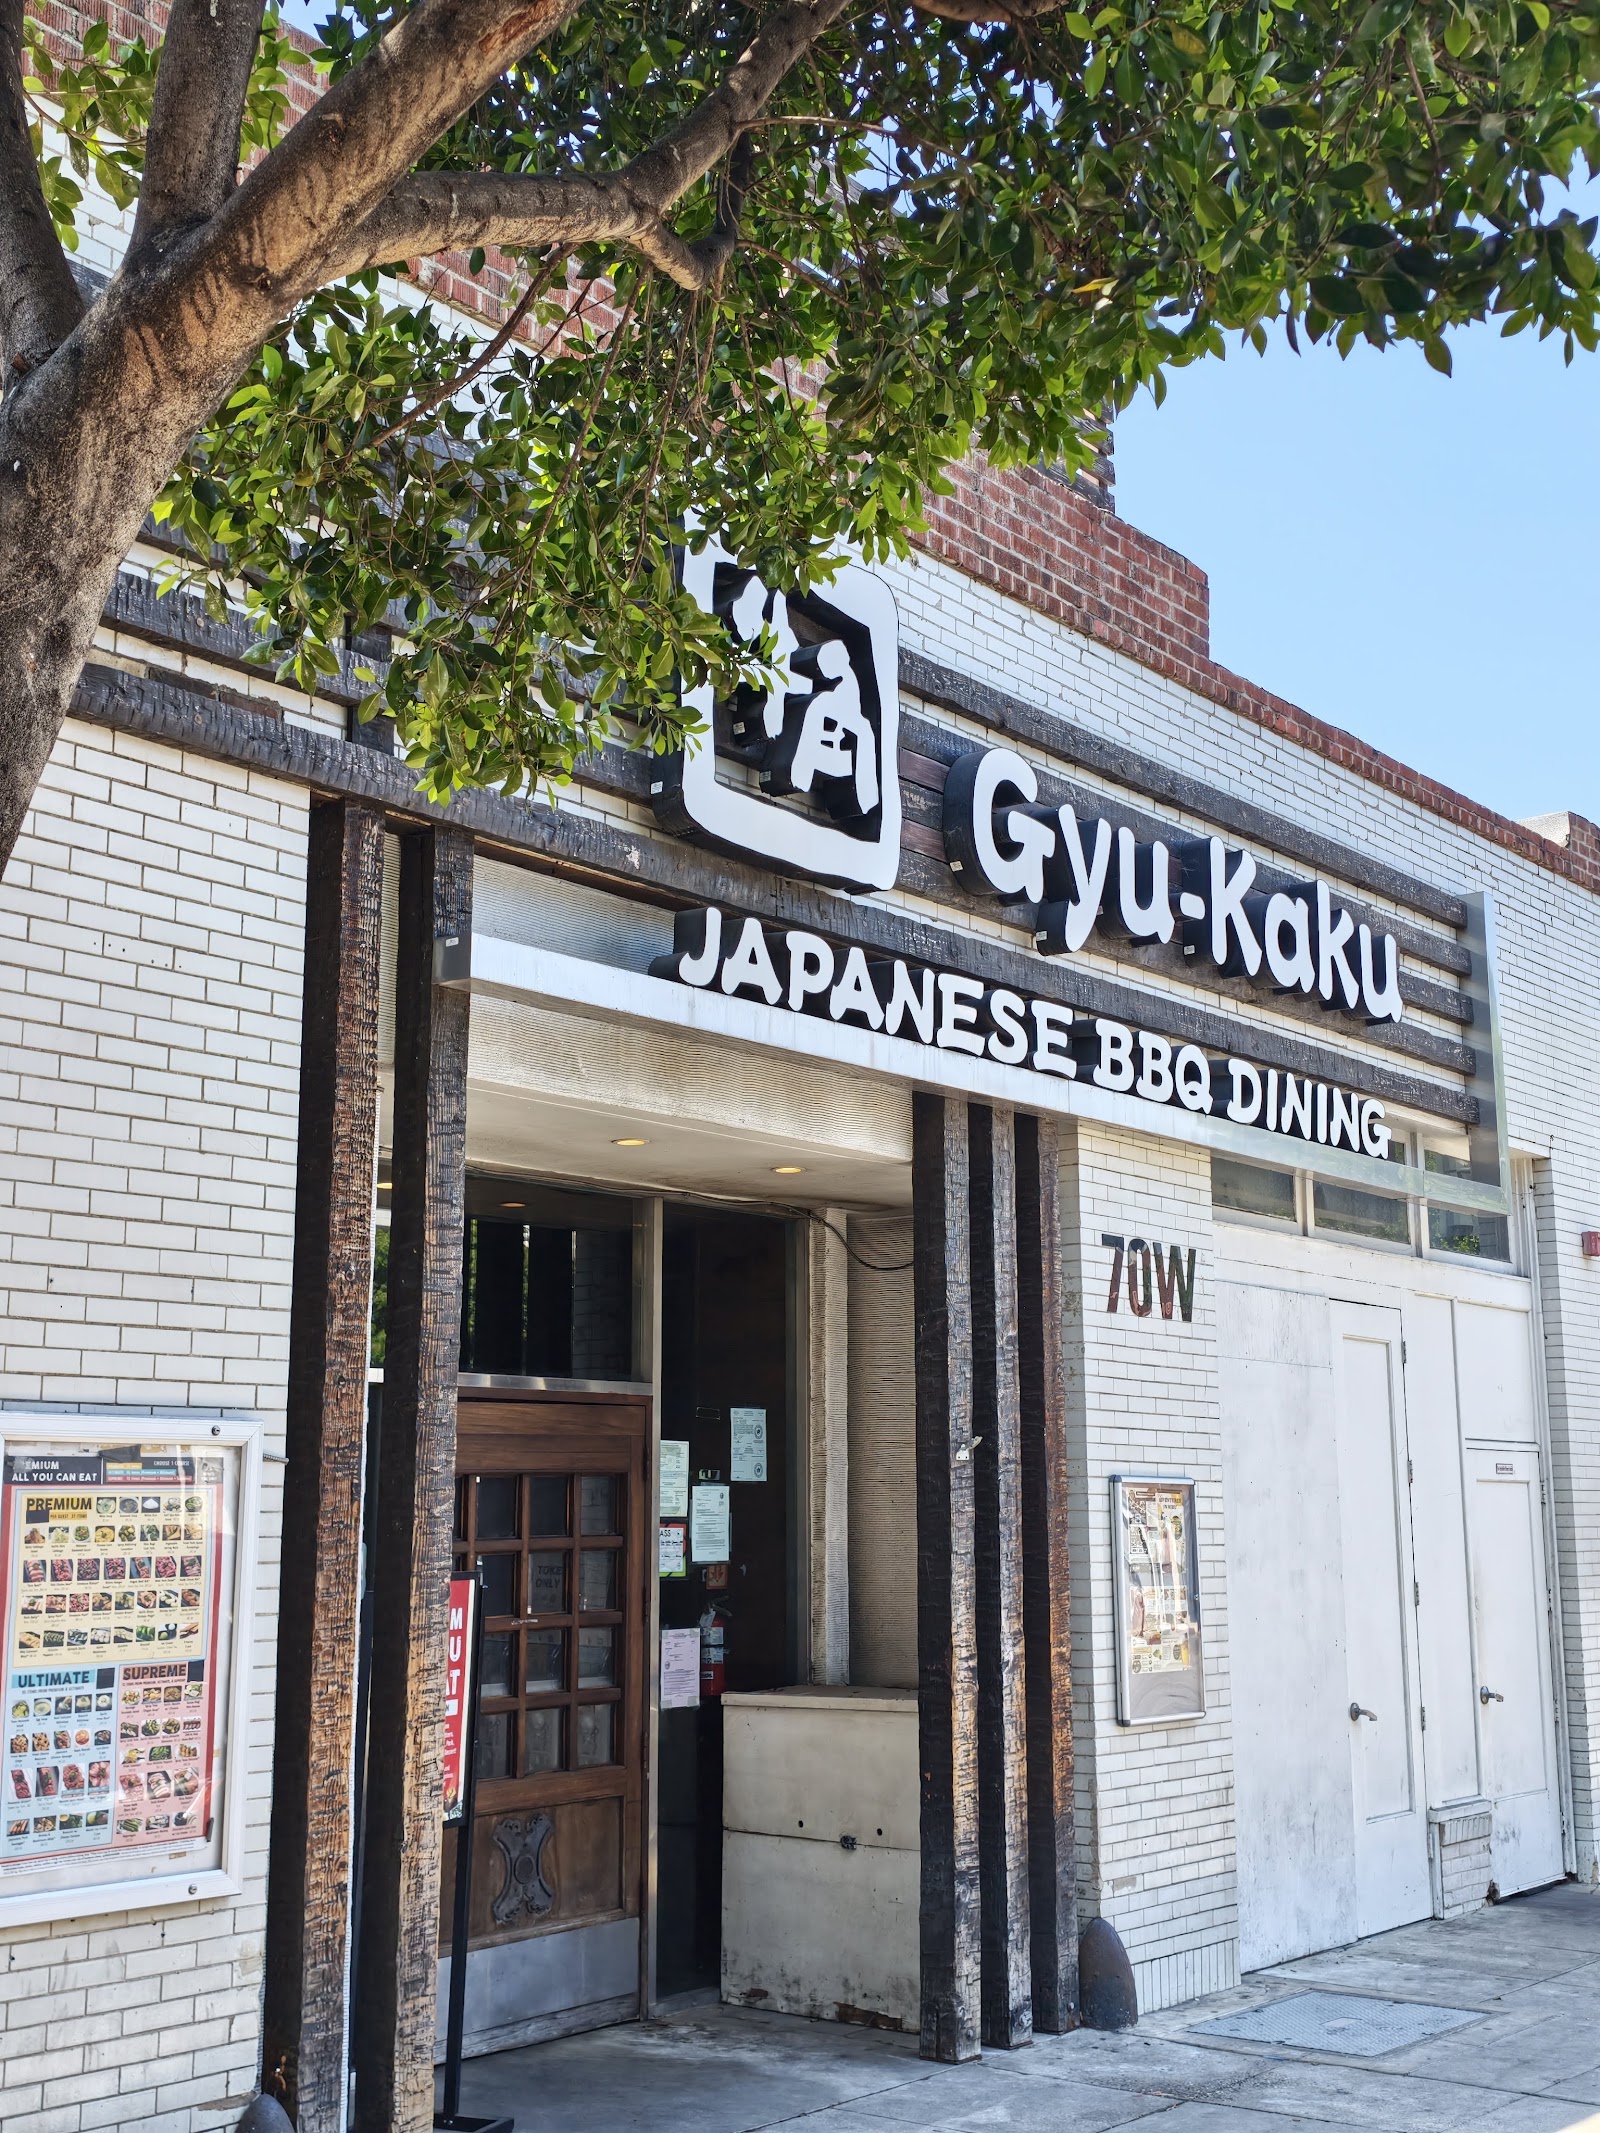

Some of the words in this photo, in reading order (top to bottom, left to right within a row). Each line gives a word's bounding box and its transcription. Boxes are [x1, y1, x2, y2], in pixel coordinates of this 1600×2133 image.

[971, 747, 1403, 1023] Gyu-Kaku
[678, 905, 1077, 1079] JAPANESE
[1092, 1017, 1213, 1115] BBQ
[1226, 1058, 1391, 1159] DINING
[1101, 1233, 1197, 1322] 70W
[12, 1473, 30, 1482] ALL
[32, 1473, 53, 1482] YOU
[56, 1473, 76, 1481] CAN
[79, 1473, 98, 1481] EAT
[27, 1498, 92, 1510] PREMIUM
[659, 1529, 671, 1537] ASS
[18, 1671, 90, 1688] ULTIMATE
[122, 1664, 187, 1681] SUPREME
